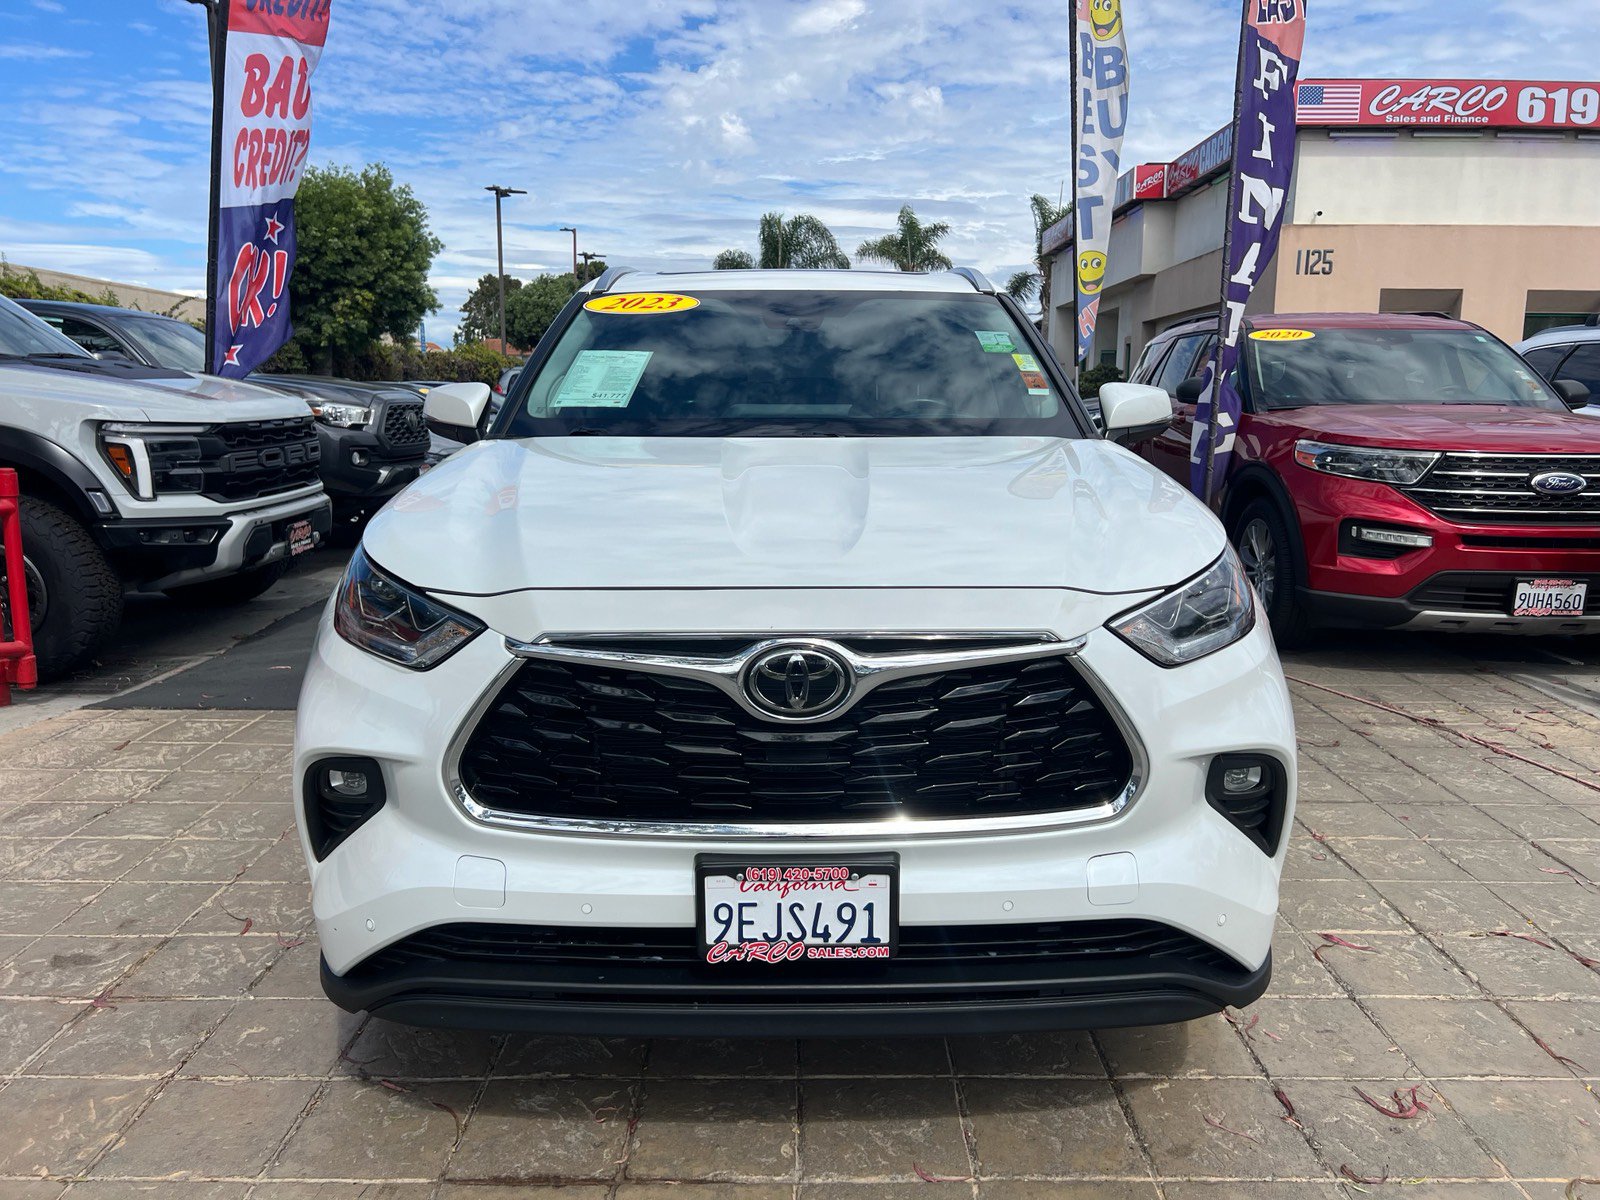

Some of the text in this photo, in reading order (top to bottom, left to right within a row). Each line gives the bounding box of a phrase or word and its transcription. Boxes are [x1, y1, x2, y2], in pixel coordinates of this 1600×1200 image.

[1368, 84, 1509, 117] CARCO
[1516, 86, 1600, 125] 619
[1385, 114, 1489, 123] Sales and Finance
[1295, 249, 1335, 275] 1125
[601, 297, 684, 310] 2023
[1259, 330, 1303, 339] 2020
[229, 440, 320, 473] FORD
[1545, 476, 1575, 489] Ford
[1517, 592, 1582, 610] 9UHA560
[746, 866, 850, 881] (619) 420-5700
[739, 878, 860, 899] California
[712, 902, 882, 943] 9EJS491
[706, 941, 890, 963] CARCO SALES.COM
